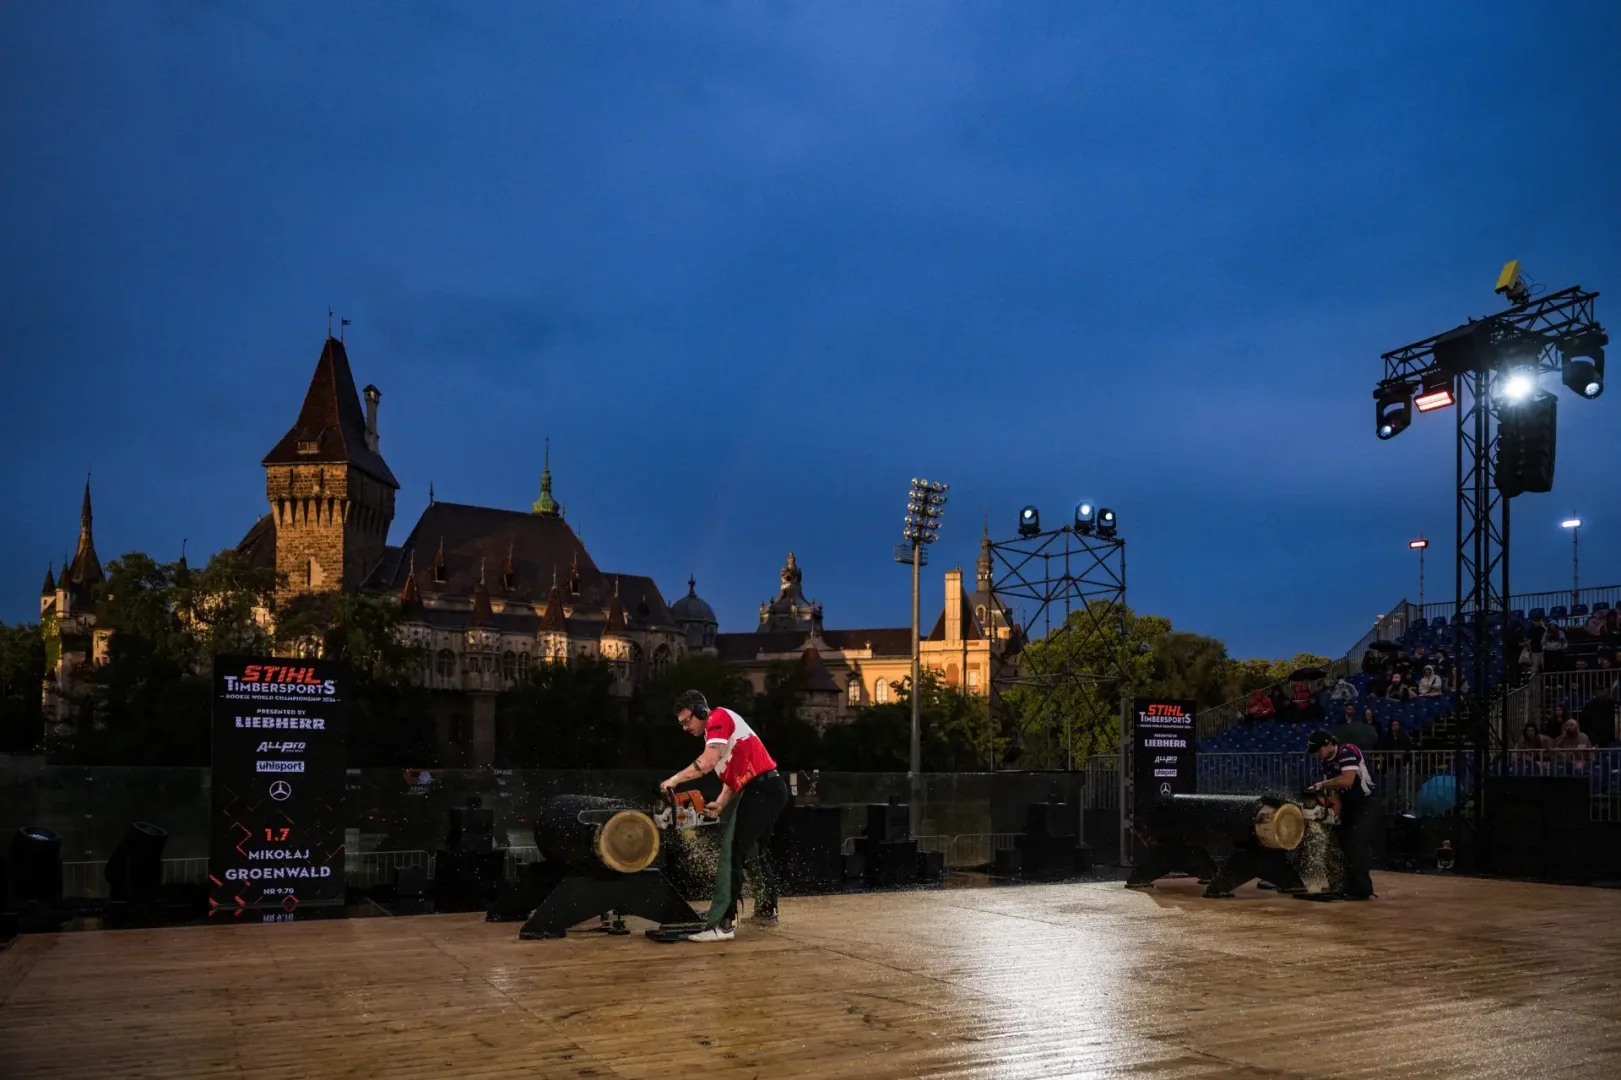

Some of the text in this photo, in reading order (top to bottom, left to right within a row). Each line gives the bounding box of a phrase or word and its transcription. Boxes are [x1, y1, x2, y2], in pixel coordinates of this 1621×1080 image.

[241, 665, 321, 684] STIHL
[224, 675, 337, 695] TIMBERSPORTS
[1147, 704, 1184, 716] STIHL
[235, 716, 325, 730] LIEBHERR
[1139, 712, 1191, 724] TIMBERSPORTS
[1144, 738, 1187, 748] LIEBHERR
[258, 761, 303, 772] uhlsport
[265, 828, 290, 841] 1.7
[248, 849, 310, 860] MIKOŁAJ
[225, 866, 331, 880] GROENWALD
[277, 887, 294, 895] 9.70
